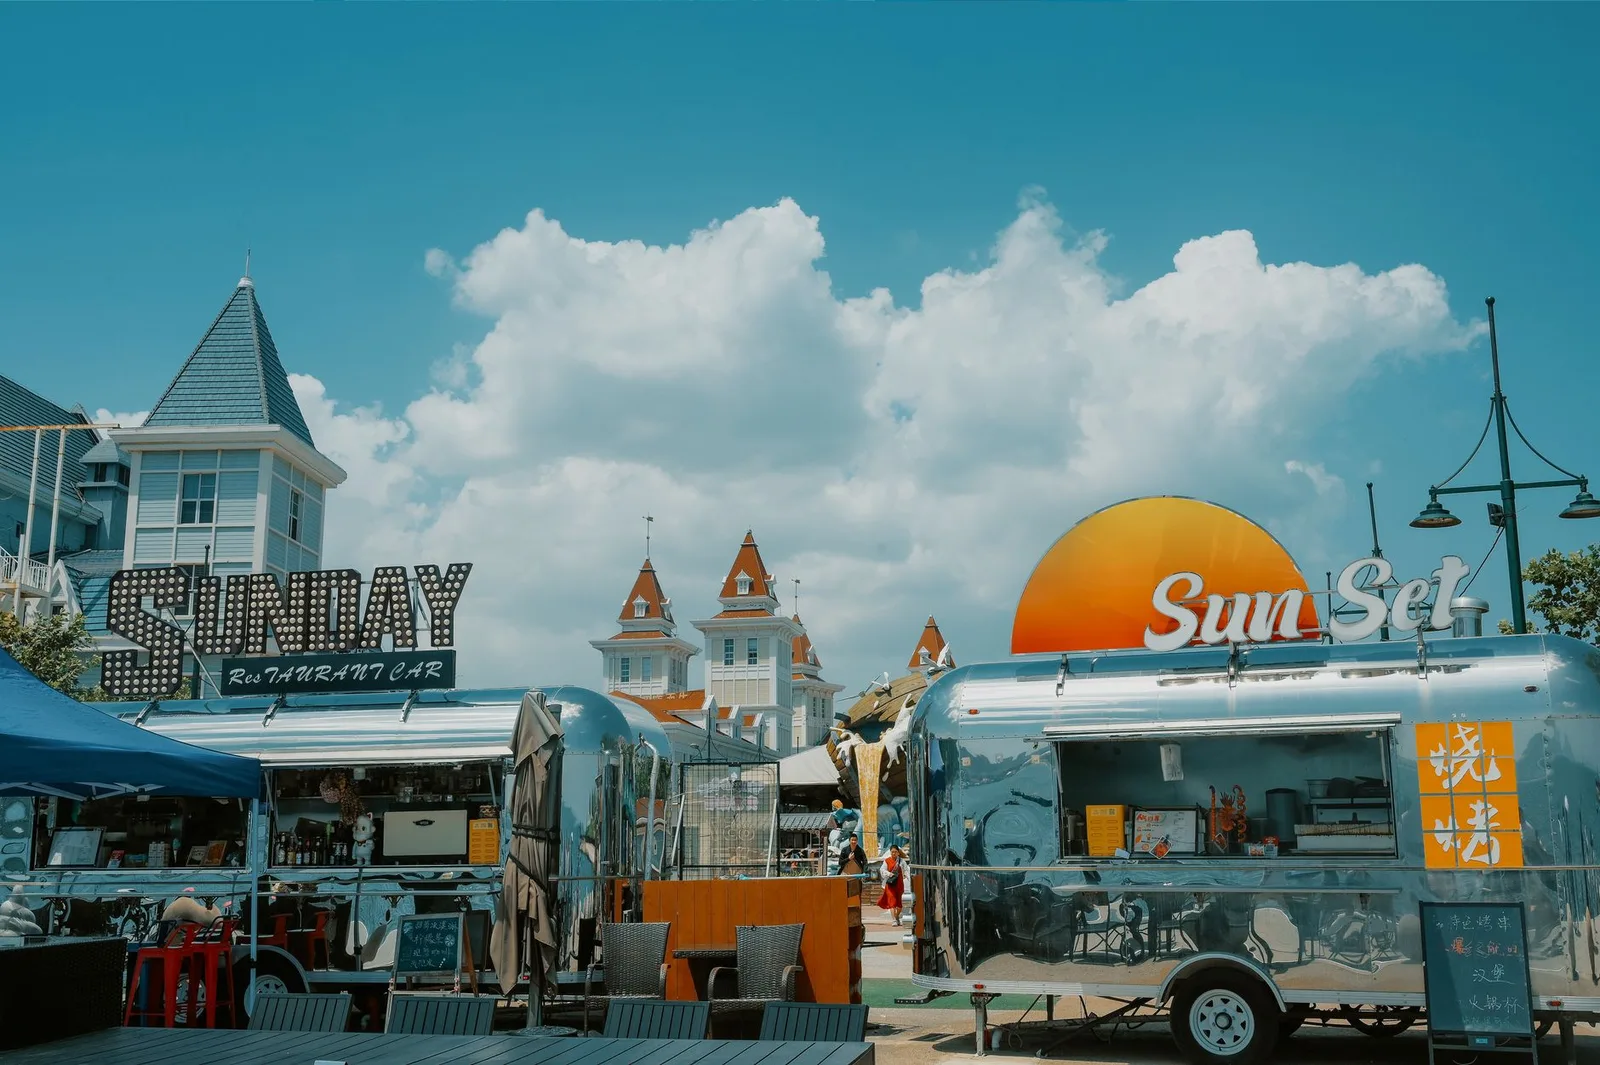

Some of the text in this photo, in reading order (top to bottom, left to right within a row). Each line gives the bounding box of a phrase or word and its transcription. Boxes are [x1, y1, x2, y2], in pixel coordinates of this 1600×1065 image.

[100, 562, 473, 696] SUNDAY
[1144, 555, 1470, 651] Sun Set
[389, 660, 444, 681] CAR
[1429, 723, 1502, 865] 烧烤
[1472, 963, 1516, 985] 汉堡
